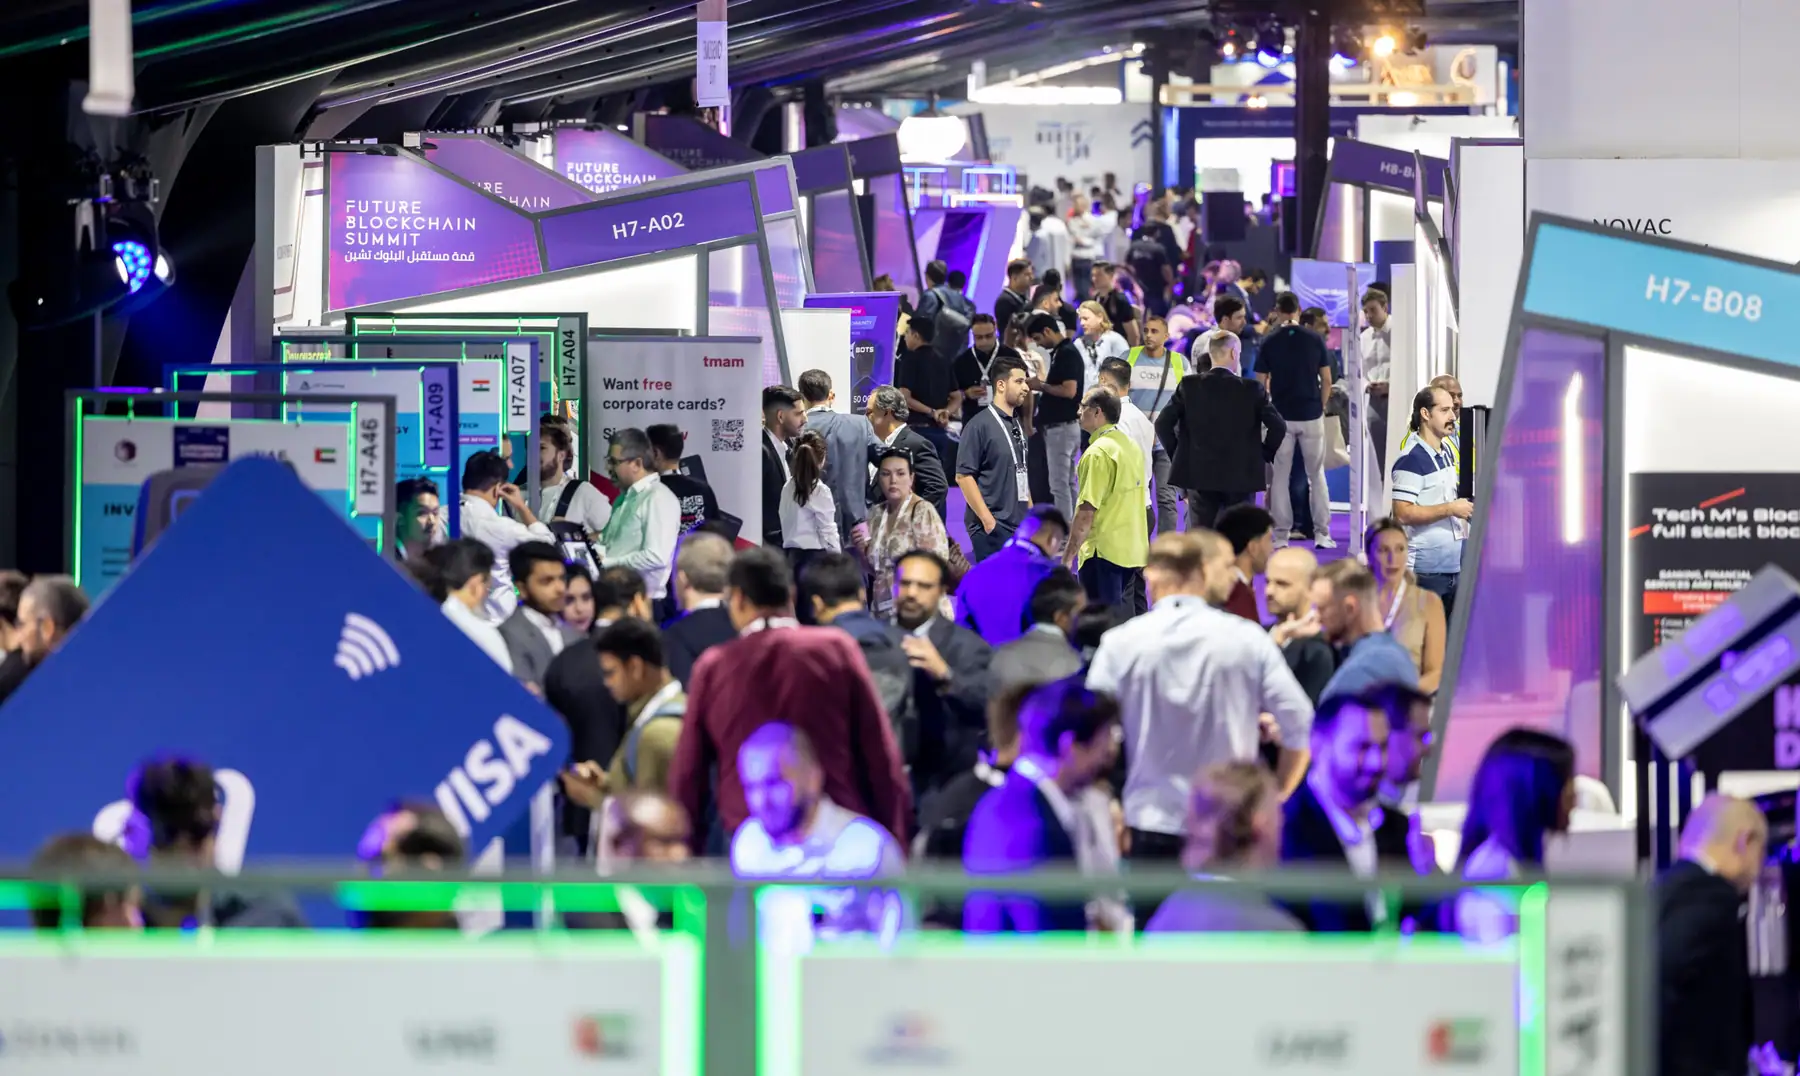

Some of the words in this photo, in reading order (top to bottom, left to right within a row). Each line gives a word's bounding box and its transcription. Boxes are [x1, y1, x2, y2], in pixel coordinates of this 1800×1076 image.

[566, 162, 619, 173] FUTURE
[346, 200, 422, 214] FUTURE
[346, 216, 476, 231] BLOCKCHAIN
[612, 212, 686, 240] H7-A02
[345, 232, 421, 246] SUMMIT
[344, 248, 372, 263] تشين
[373, 249, 405, 264] البلوك
[406, 249, 450, 264] مستقبل
[451, 250, 476, 262] قمة
[1644, 273, 1763, 322] H7-B08
[562, 329, 576, 386] H7-A04
[703, 355, 745, 368] tmam
[511, 355, 526, 417] H7-A07
[603, 377, 640, 391] Want
[642, 377, 673, 391] free
[602, 398, 674, 413] corporate
[677, 397, 726, 411] cards?
[428, 382, 444, 451] H7-A09
[360, 418, 378, 496] H7-A46
[1652, 507, 1705, 523] Tech
[1709, 506, 1749, 523] M's
[1753, 506, 1800, 523] Bloc
[1652, 523, 1686, 539] full
[1690, 523, 1752, 539] stack
[434, 713, 553, 838] VISA
